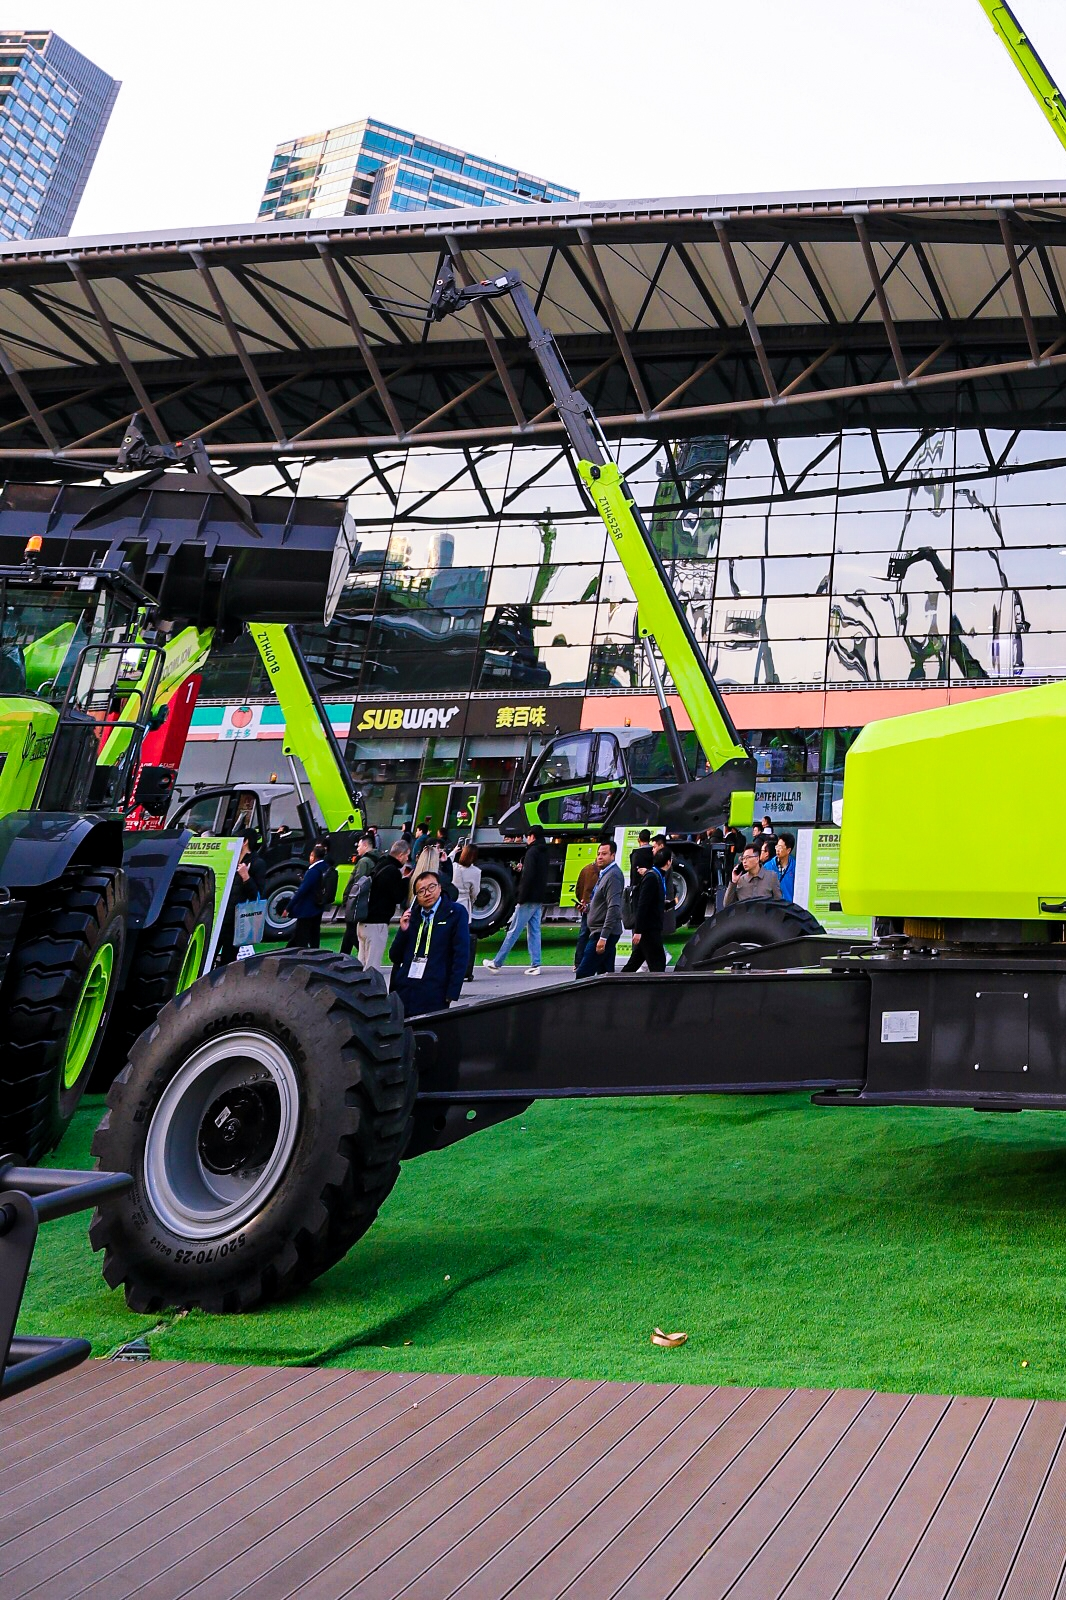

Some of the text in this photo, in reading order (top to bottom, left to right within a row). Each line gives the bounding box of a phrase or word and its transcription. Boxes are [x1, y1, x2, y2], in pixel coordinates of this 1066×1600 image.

[598, 496, 624, 541] ZTH4525R
[257, 631, 280, 674] ZTH4018
[356, 705, 460, 732] SUBWAY
[495, 705, 547, 729] 赛百味
[755, 791, 802, 802] CATERPILLAR
[762, 802, 794, 813] 卡特彼勒
